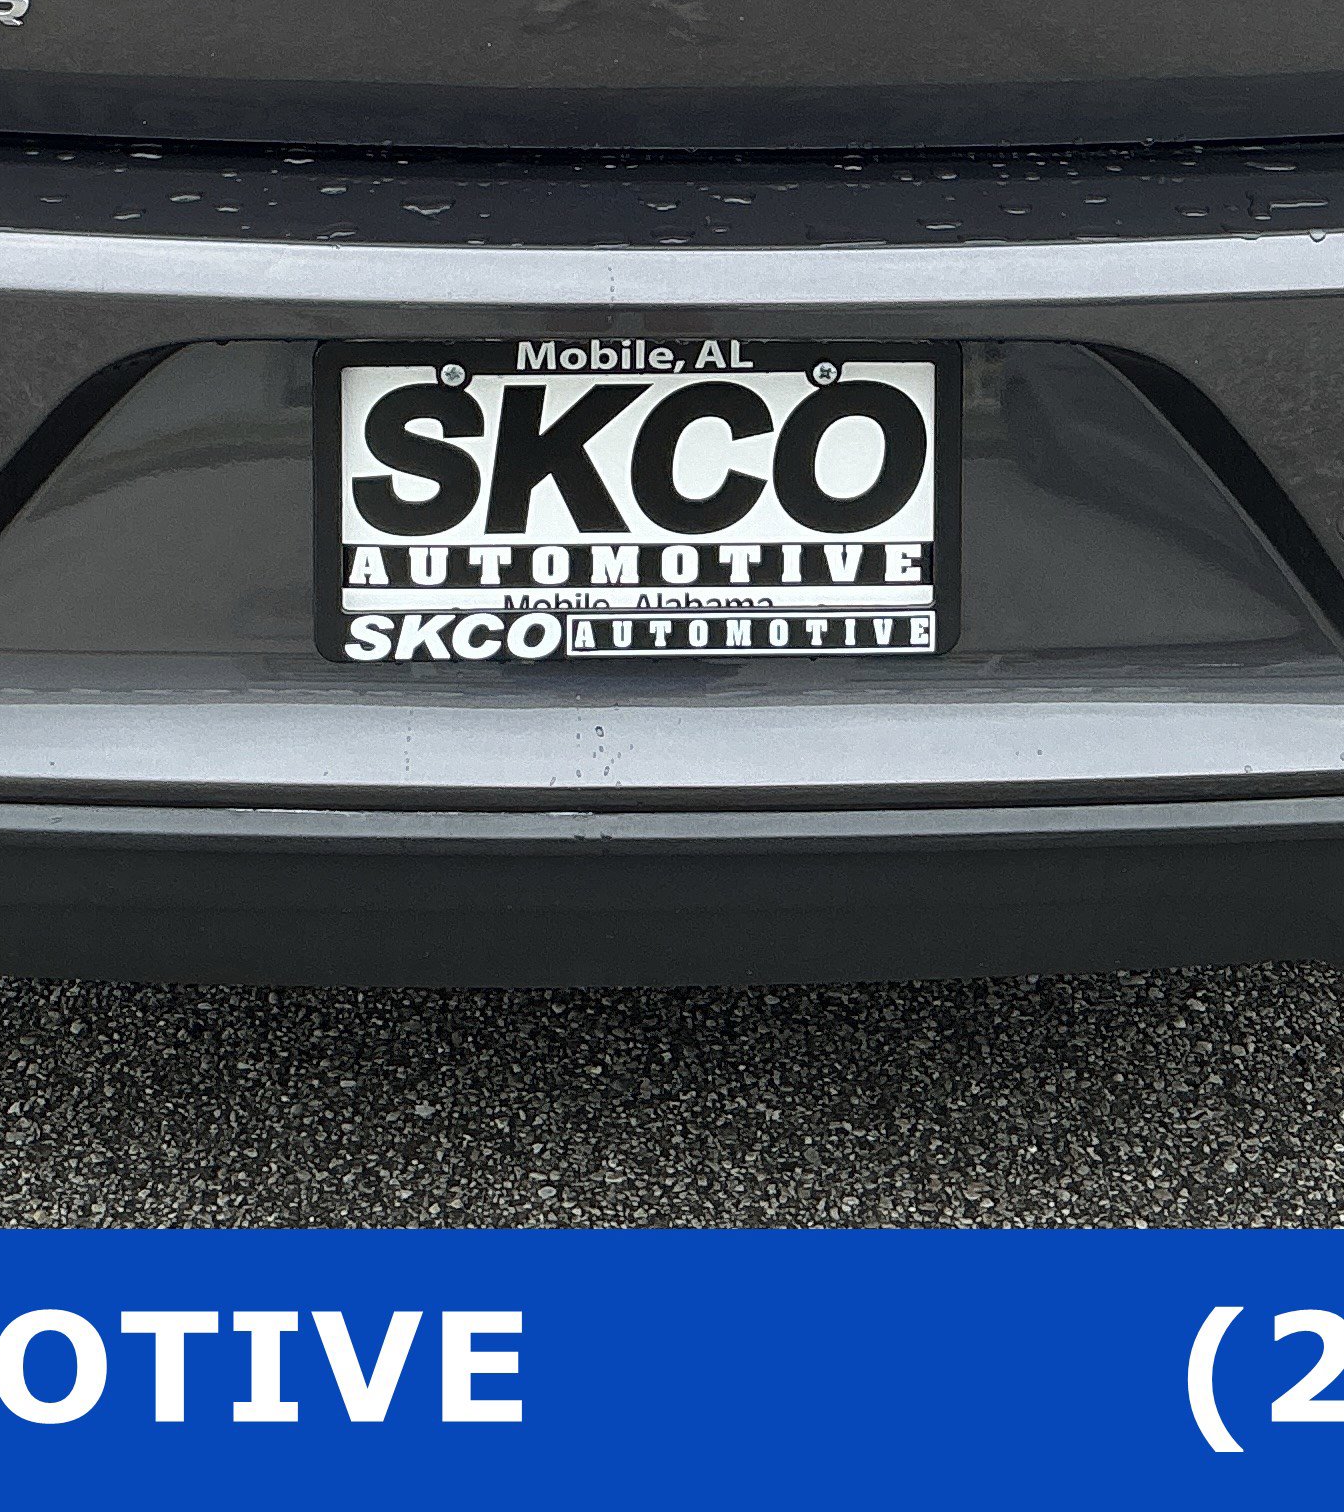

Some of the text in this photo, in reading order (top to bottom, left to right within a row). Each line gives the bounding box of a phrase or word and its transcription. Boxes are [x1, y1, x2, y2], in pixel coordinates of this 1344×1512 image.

[516, 338, 755, 374] Mobile, AL
[351, 378, 928, 537] SKCO
[348, 543, 923, 587] AUTOMOTIVE
[344, 611, 563, 662] SKCO
[572, 617, 931, 649] AUTOMOTIVE
